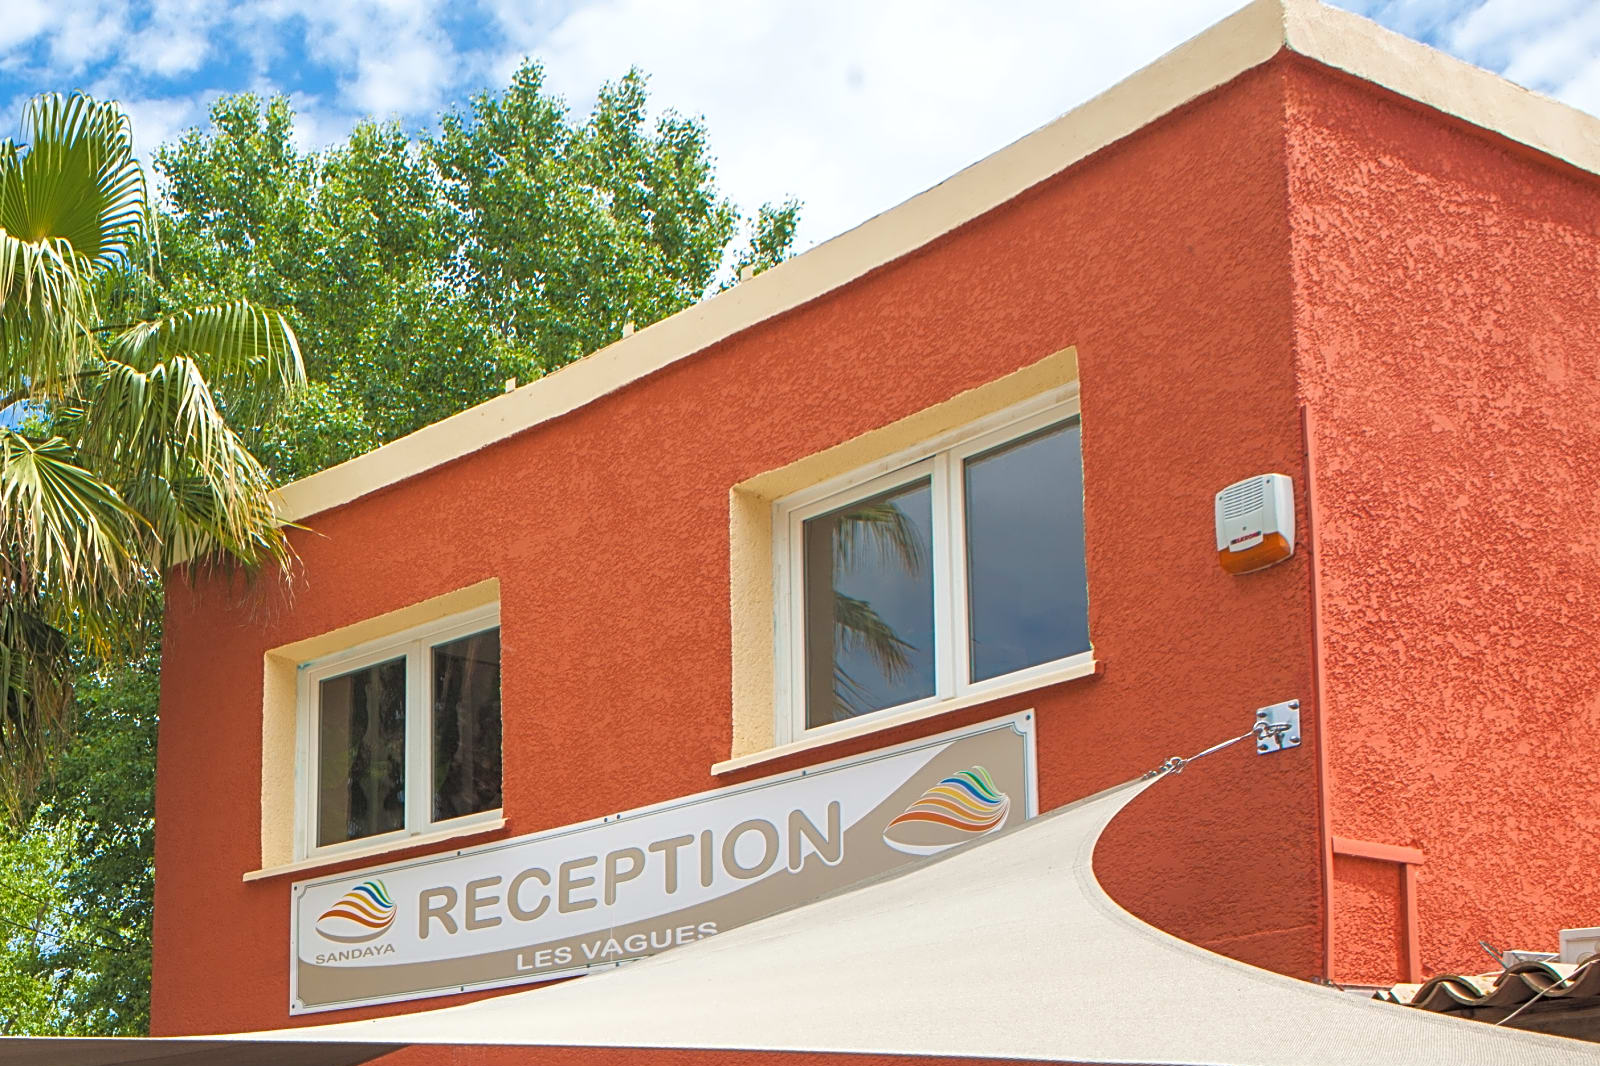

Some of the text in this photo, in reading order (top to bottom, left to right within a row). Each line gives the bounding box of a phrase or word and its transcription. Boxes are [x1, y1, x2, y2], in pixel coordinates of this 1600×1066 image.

[418, 800, 841, 940] RECEPTION
[315, 944, 395, 965] SANDAYA
[516, 921, 718, 971] LES VAGUES
